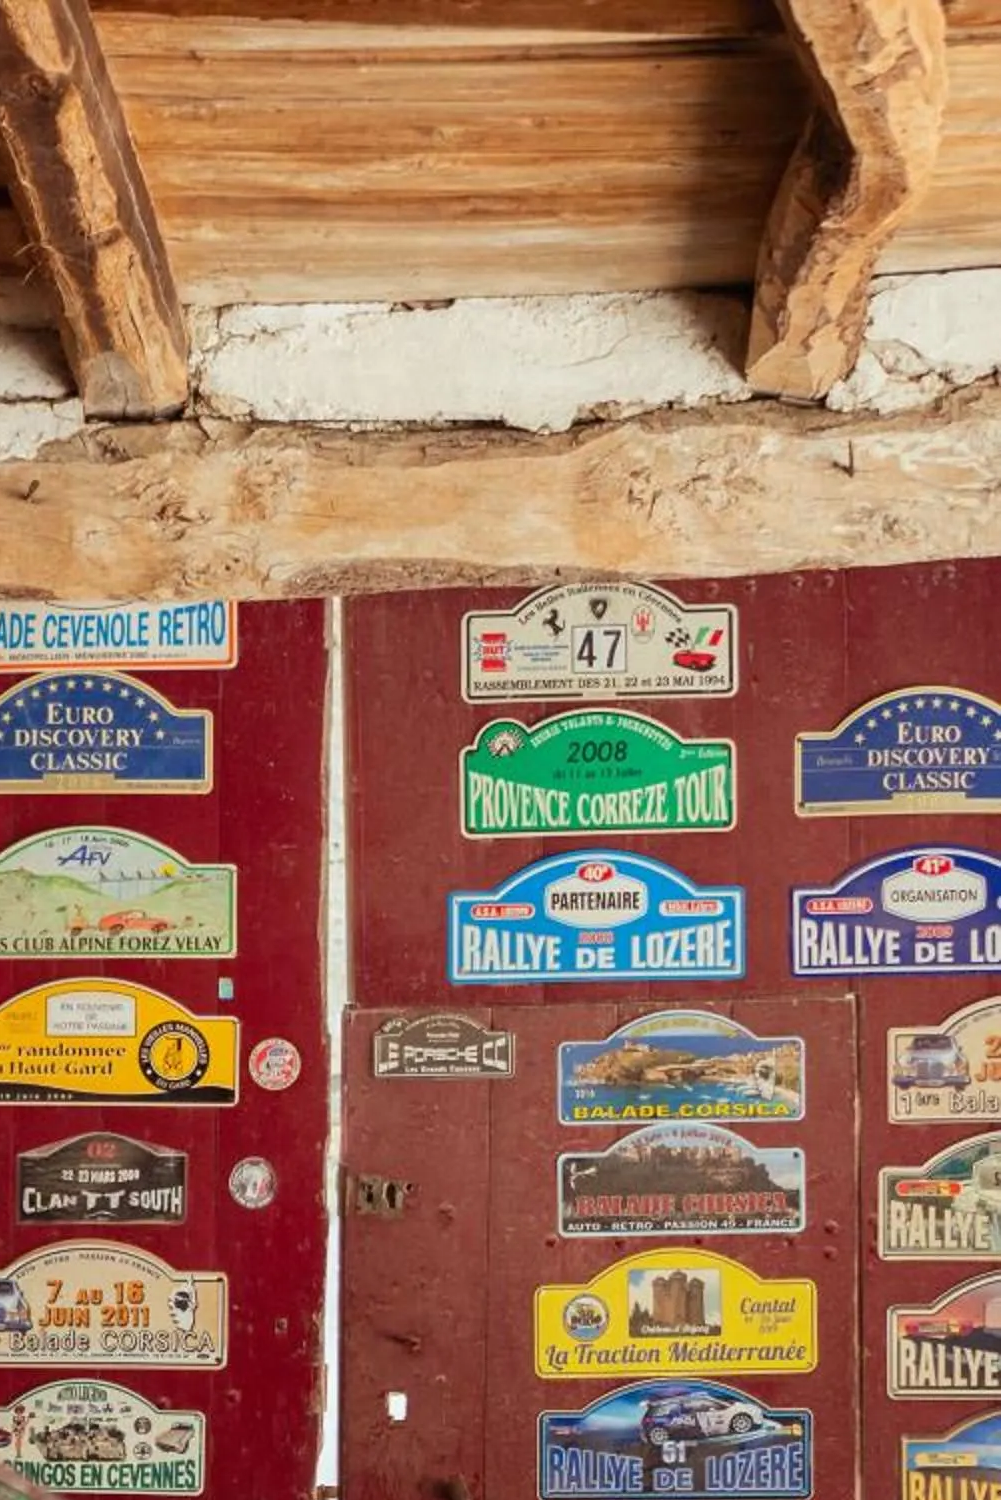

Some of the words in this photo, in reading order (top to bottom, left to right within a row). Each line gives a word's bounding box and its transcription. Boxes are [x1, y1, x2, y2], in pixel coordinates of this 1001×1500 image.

[622, 586, 636, 596] en
[42, 611, 149, 648] CEVENOLE
[158, 600, 226, 646] RETRO
[576, 629, 622, 669] 47
[473, 678, 574, 692] RASSEMBLEMENT
[578, 677, 600, 689] DES
[624, 677, 638, 688] 22
[641, 677, 652, 687] et
[655, 676, 670, 687] 23
[672, 676, 695, 687] MAI
[14, 728, 144, 747] DISCOVERY
[30, 752, 128, 771] CLASSIC
[566, 739, 628, 764] 2008
[867, 747, 991, 768] DISCOVERY
[882, 771, 976, 791] CLASSIC
[468, 770, 571, 829] PROVENCE
[576, 782, 668, 826] CORREZE
[674, 764, 728, 823] TOUR
[551, 891, 640, 911] PARTENAIRE
[890, 889, 978, 904] ORGANISATION
[12, 936, 55, 951] CLUB
[60, 936, 114, 952] ALPINE
[119, 935, 171, 951] FOREZ
[176, 935, 222, 951] VELAY
[462, 924, 562, 972] RALLYE
[576, 947, 616, 969] DE
[631, 920, 732, 968] LOZERE
[800, 918, 901, 967] RALLYE
[914, 941, 954, 964] DE
[573, 1104, 671, 1121] BALADE
[675, 1102, 789, 1118] CORSICA
[22, 1187, 77, 1215] CLAN
[128, 1185, 183, 1216] SOUTH
[567, 1222, 601, 1232] AUTO
[611, 1221, 654, 1231] RETRO
[664, 1220, 718, 1230] PASSION
[747, 1217, 796, 1228] FRANCE
[890, 1199, 993, 1250] RALLYE
[46, 1279, 63, 1305] 7
[113, 1279, 144, 1304] 16
[38, 1306, 90, 1328] JUIN
[100, 1306, 150, 1328] 2011
[740, 1296, 797, 1315] Cantal
[7, 1329, 91, 1352] Balade
[100, 1329, 216, 1353] CORSICA
[545, 1344, 568, 1370] La
[574, 1342, 660, 1365] Traction
[668, 1339, 807, 1364] Méditerranée
[899, 1339, 999, 1388] RALLYE
[662, 1440, 687, 1464] 51
[9, 1460, 76, 1487] RINGOS
[81, 1463, 103, 1487] EN
[107, 1460, 196, 1488] CEVENNES
[548, 1445, 644, 1492] RALLYE
[653, 1467, 694, 1491] DE
[705, 1442, 804, 1491] LOZERE
